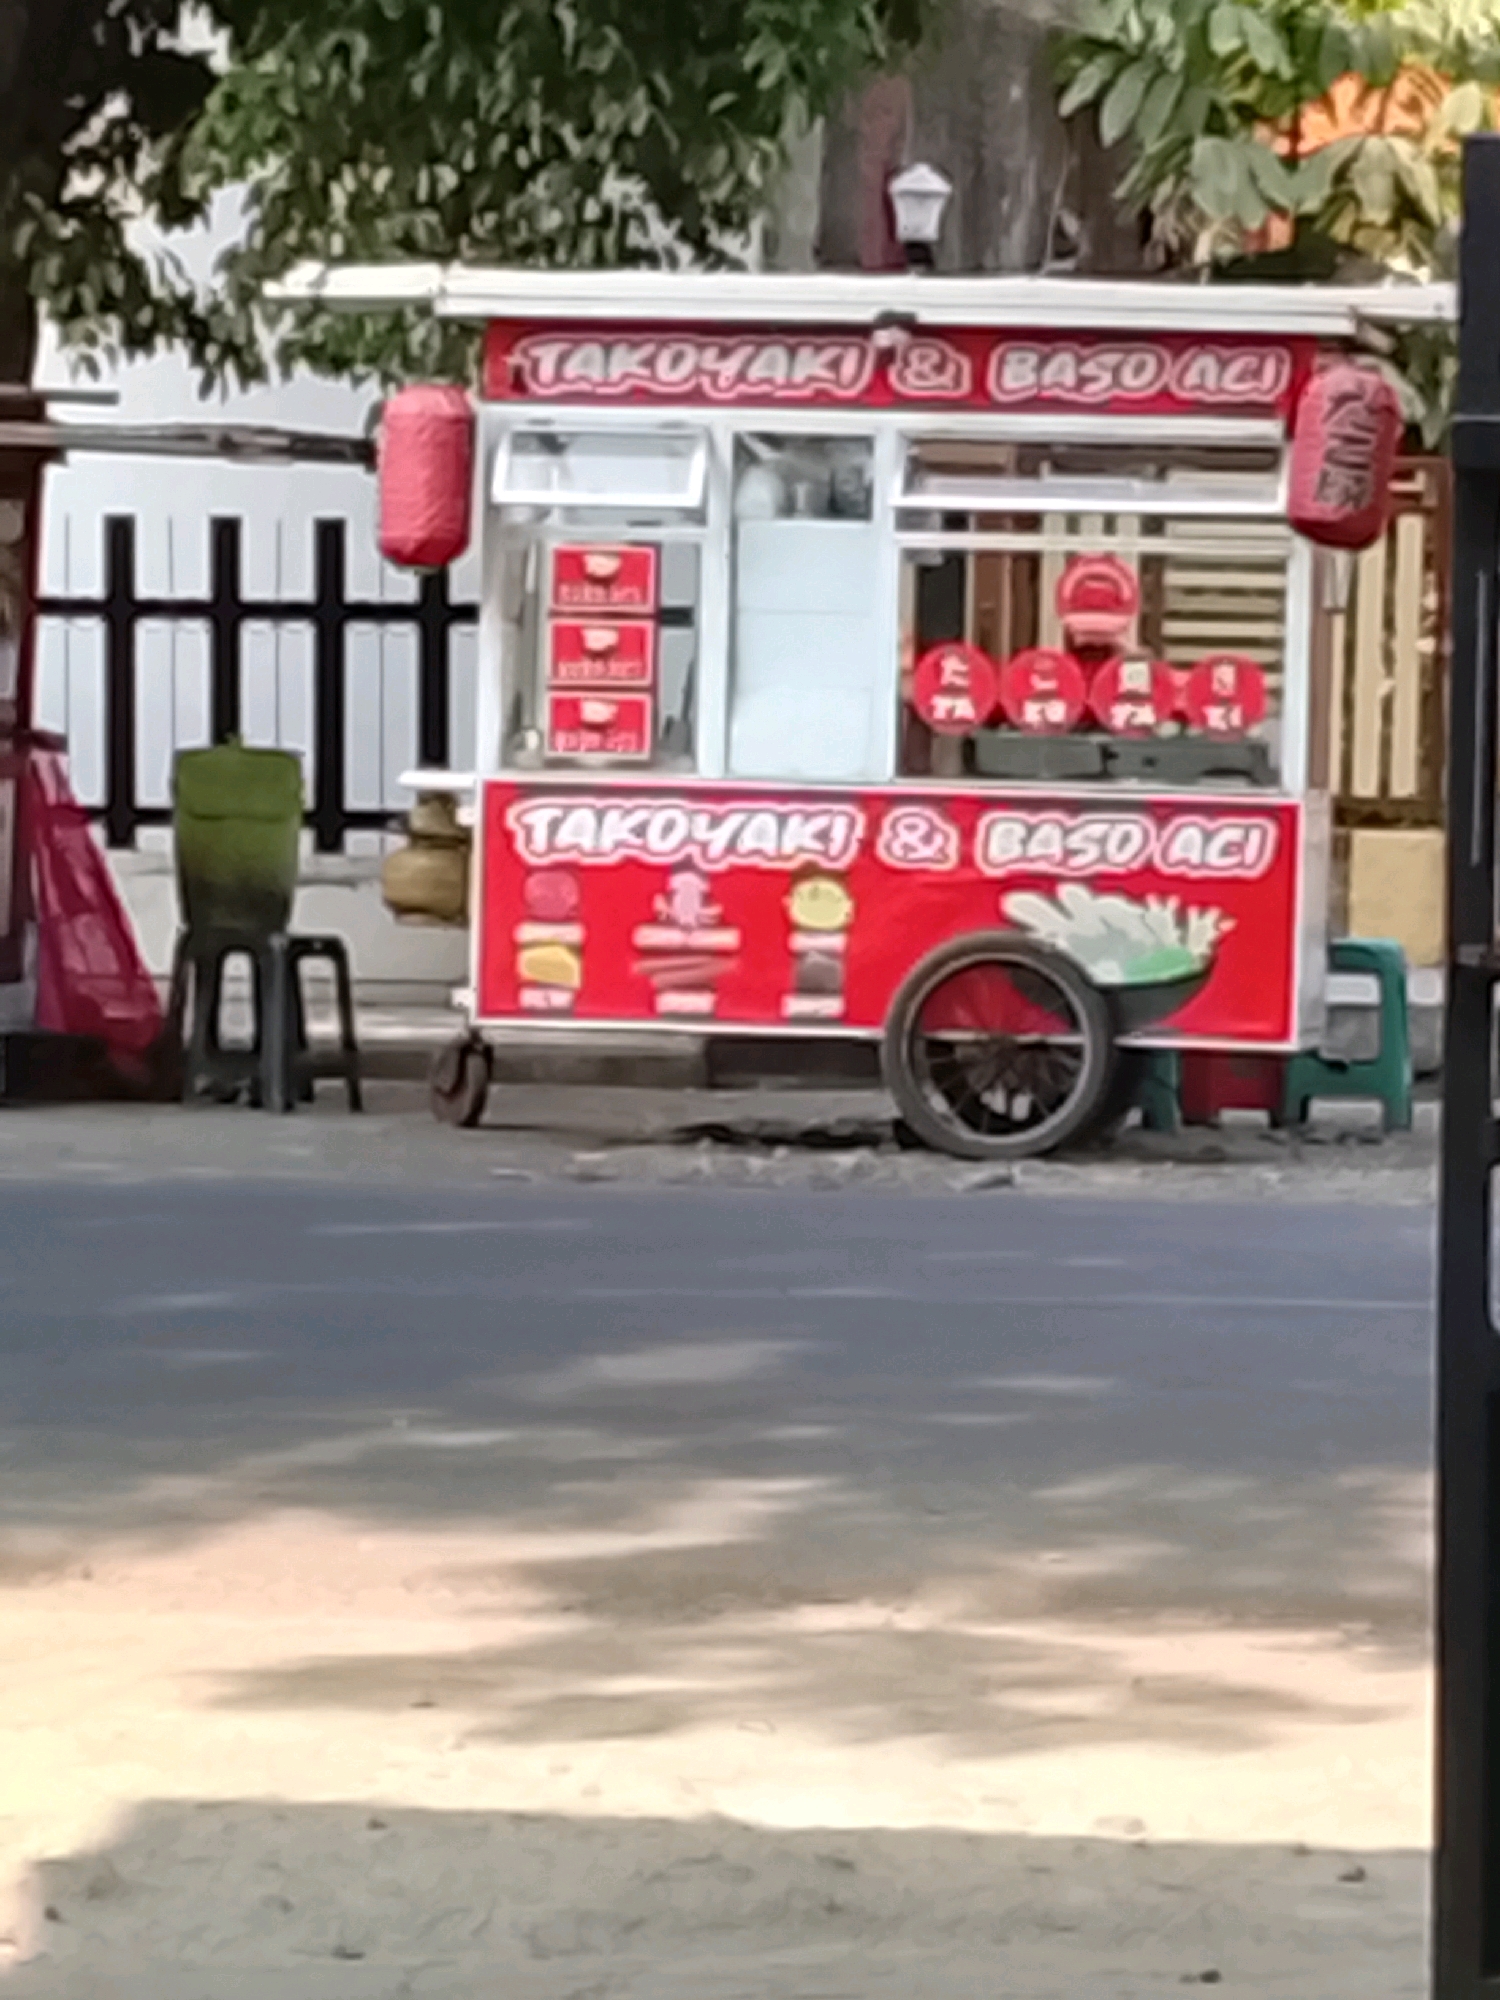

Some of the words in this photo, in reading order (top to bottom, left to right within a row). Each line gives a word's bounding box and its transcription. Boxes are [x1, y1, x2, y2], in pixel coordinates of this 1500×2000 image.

[528, 340, 860, 390] TAKOYAKI
[902, 344, 959, 388] &
[1002, 348, 1156, 396] BASO
[1183, 350, 1279, 392] ACI
[519, 805, 852, 859] TAKOYAKI
[890, 813, 948, 862] &
[986, 816, 1146, 868] BASO
[1167, 822, 1266, 869] ACI
